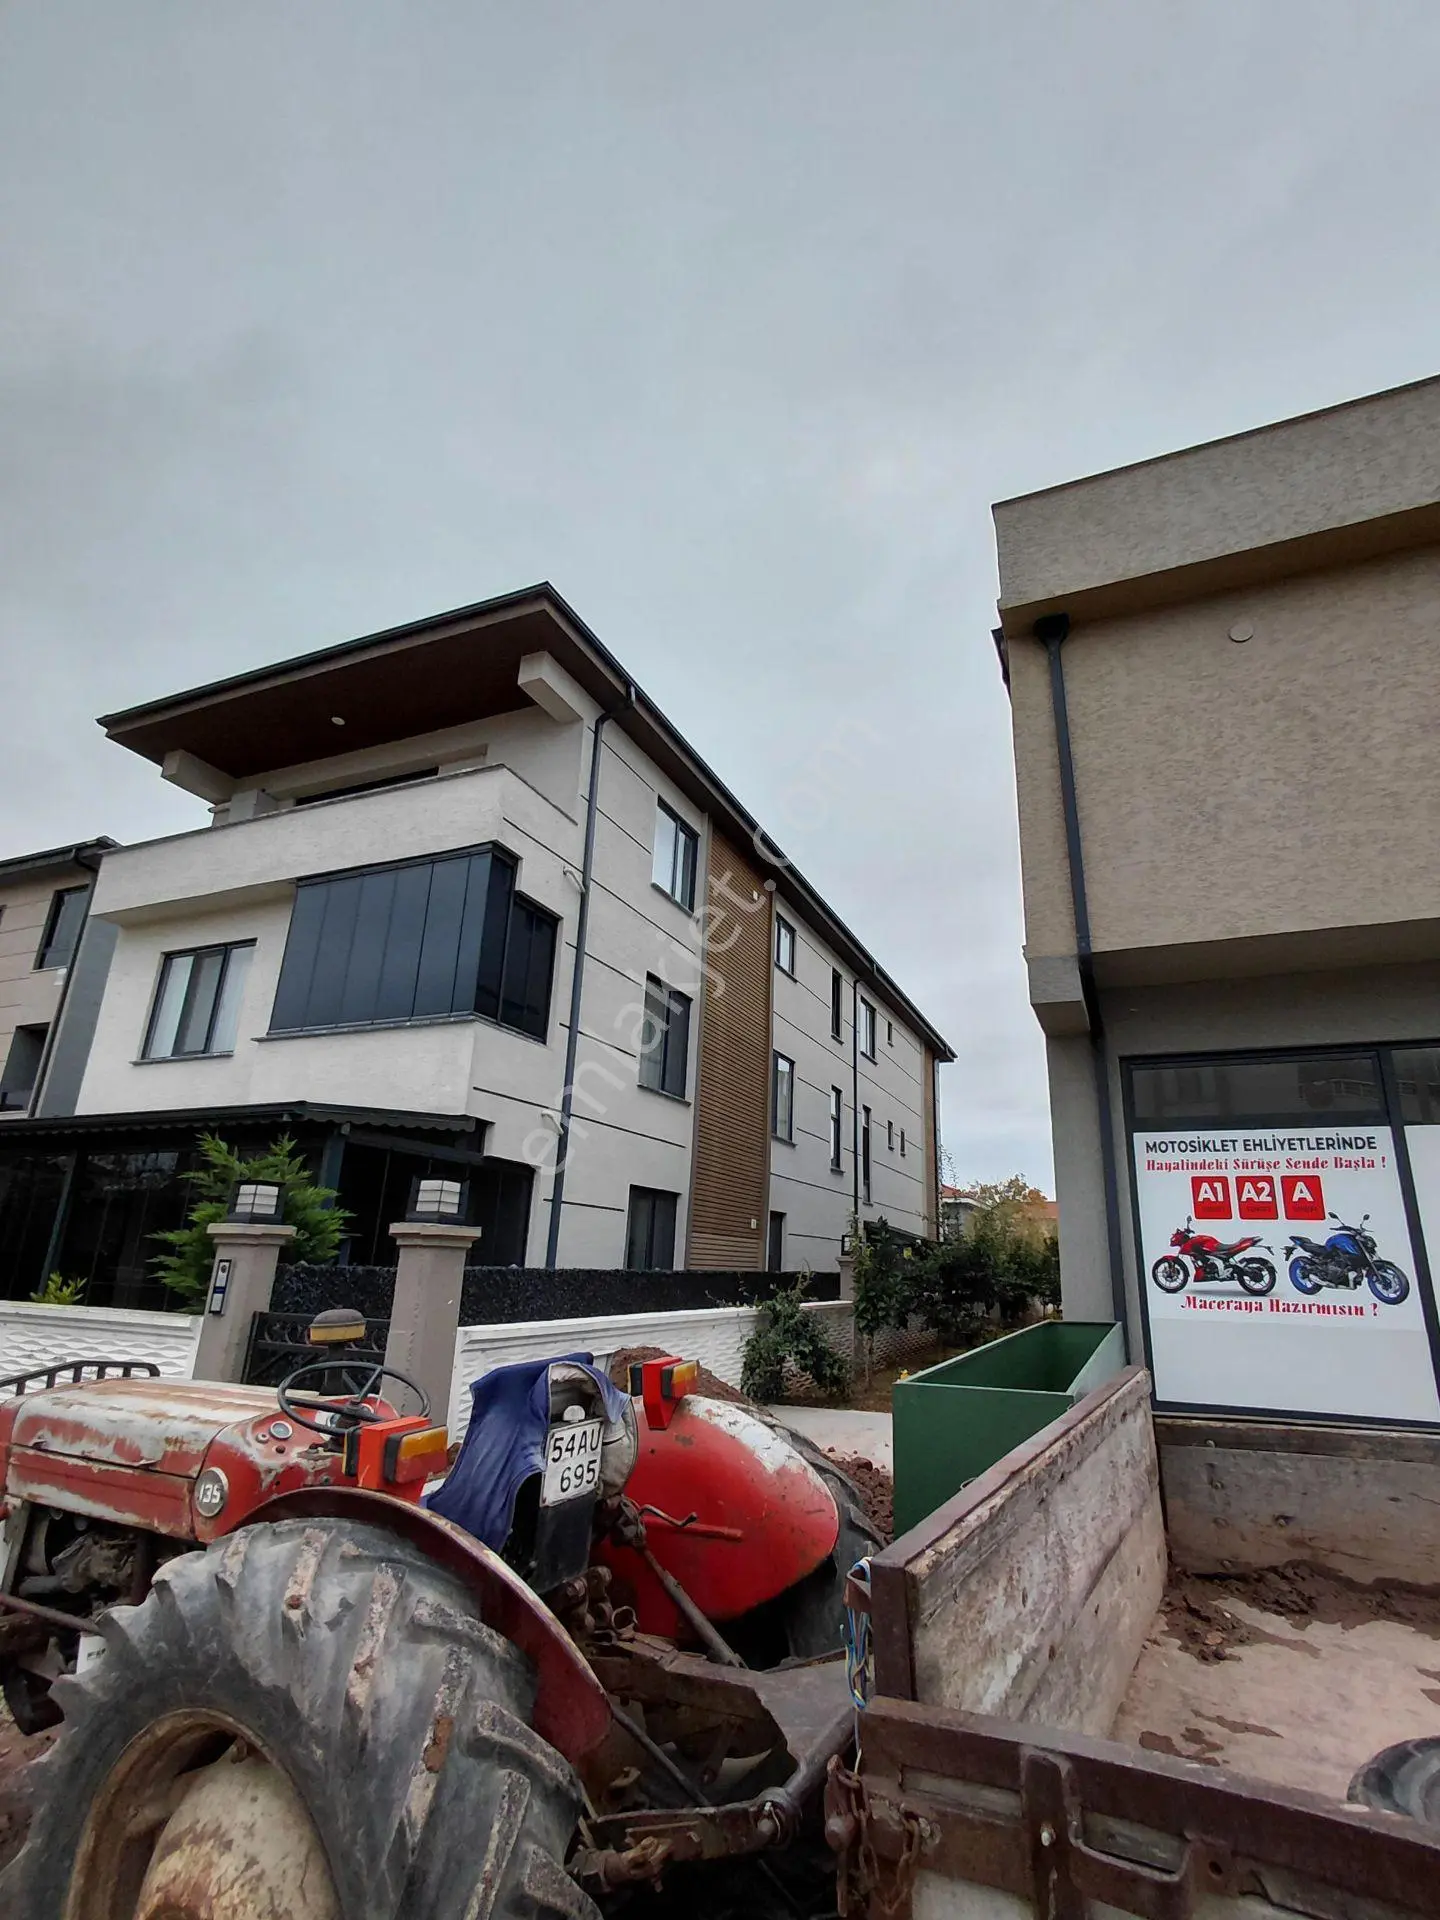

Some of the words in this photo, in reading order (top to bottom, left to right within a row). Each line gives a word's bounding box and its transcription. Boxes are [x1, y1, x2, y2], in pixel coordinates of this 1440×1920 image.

[1145, 1135, 1239, 1154] MOTOSİKLET
[1242, 1132, 1378, 1152] EHLİYETLERİNDE
[1146, 1158, 1229, 1173] Hayalindeki
[1232, 1157, 1281, 1172] Sürüşe
[1284, 1156, 1329, 1170] Sende
[1333, 1155, 1376, 1172] Başla
[1197, 1181, 1224, 1202] A1
[1239, 1181, 1273, 1202] A2
[1291, 1181, 1315, 1202] A
[1180, 1295, 1264, 1314] Maceraya
[1268, 1298, 1366, 1317] Hazırmısın
[550, 1427, 602, 1463] 54AU
[559, 1458, 598, 1493] 695
[199, 1483, 221, 1503] 135
